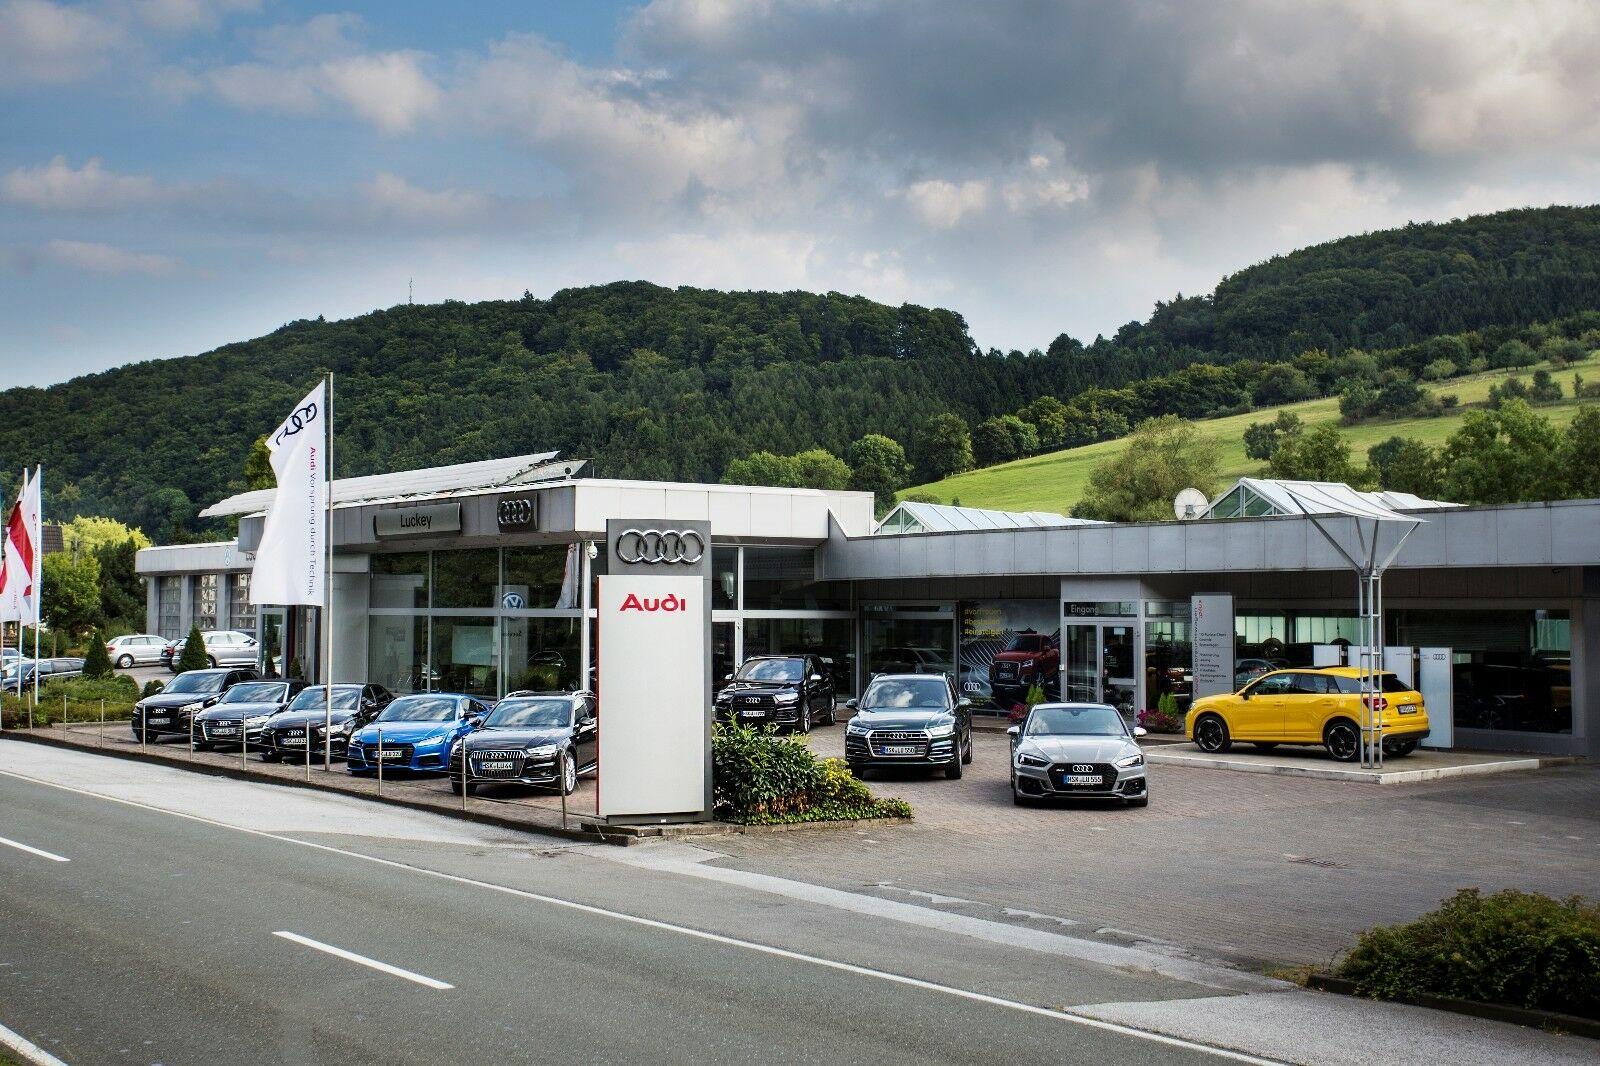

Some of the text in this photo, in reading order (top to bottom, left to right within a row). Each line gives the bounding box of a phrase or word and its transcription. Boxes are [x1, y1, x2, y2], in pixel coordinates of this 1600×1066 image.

[400, 513, 432, 529] Luckey
[307, 559, 317, 595] Technik
[620, 594, 685, 611] Audi
[1070, 604, 1099, 616] Eingang
